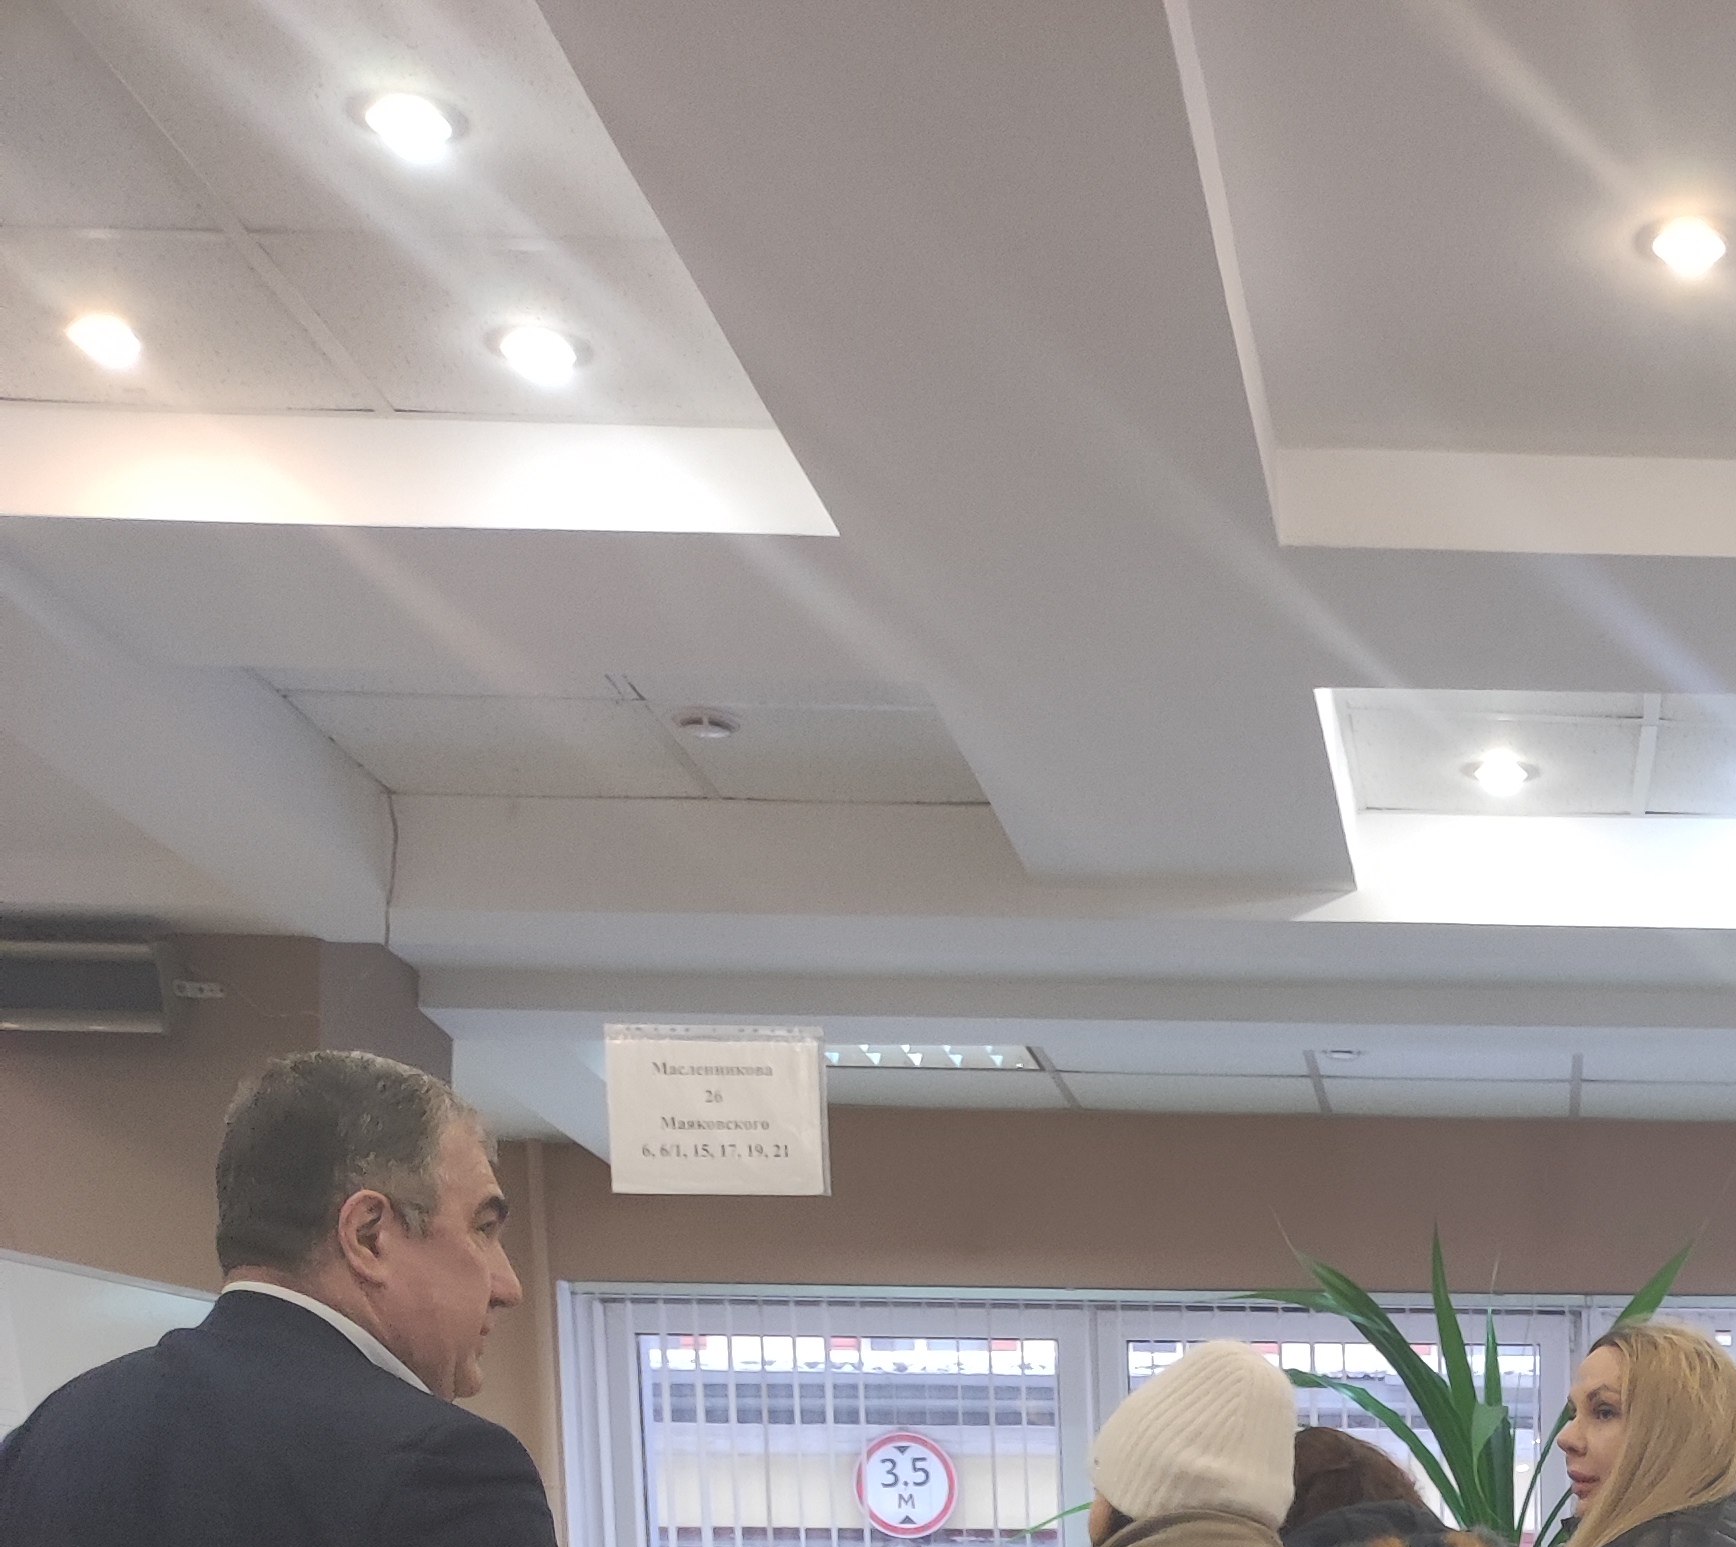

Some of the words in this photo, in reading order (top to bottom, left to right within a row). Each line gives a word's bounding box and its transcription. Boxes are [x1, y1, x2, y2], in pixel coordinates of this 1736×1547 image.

[652, 1062, 773, 1077] Масленникова
[705, 1090, 723, 1103] 26
[661, 1117, 769, 1131] Маяковского
[773, 1144, 788, 1158] 21
[880, 1457, 930, 1488] 3.5
[898, 1493, 916, 1509] М
